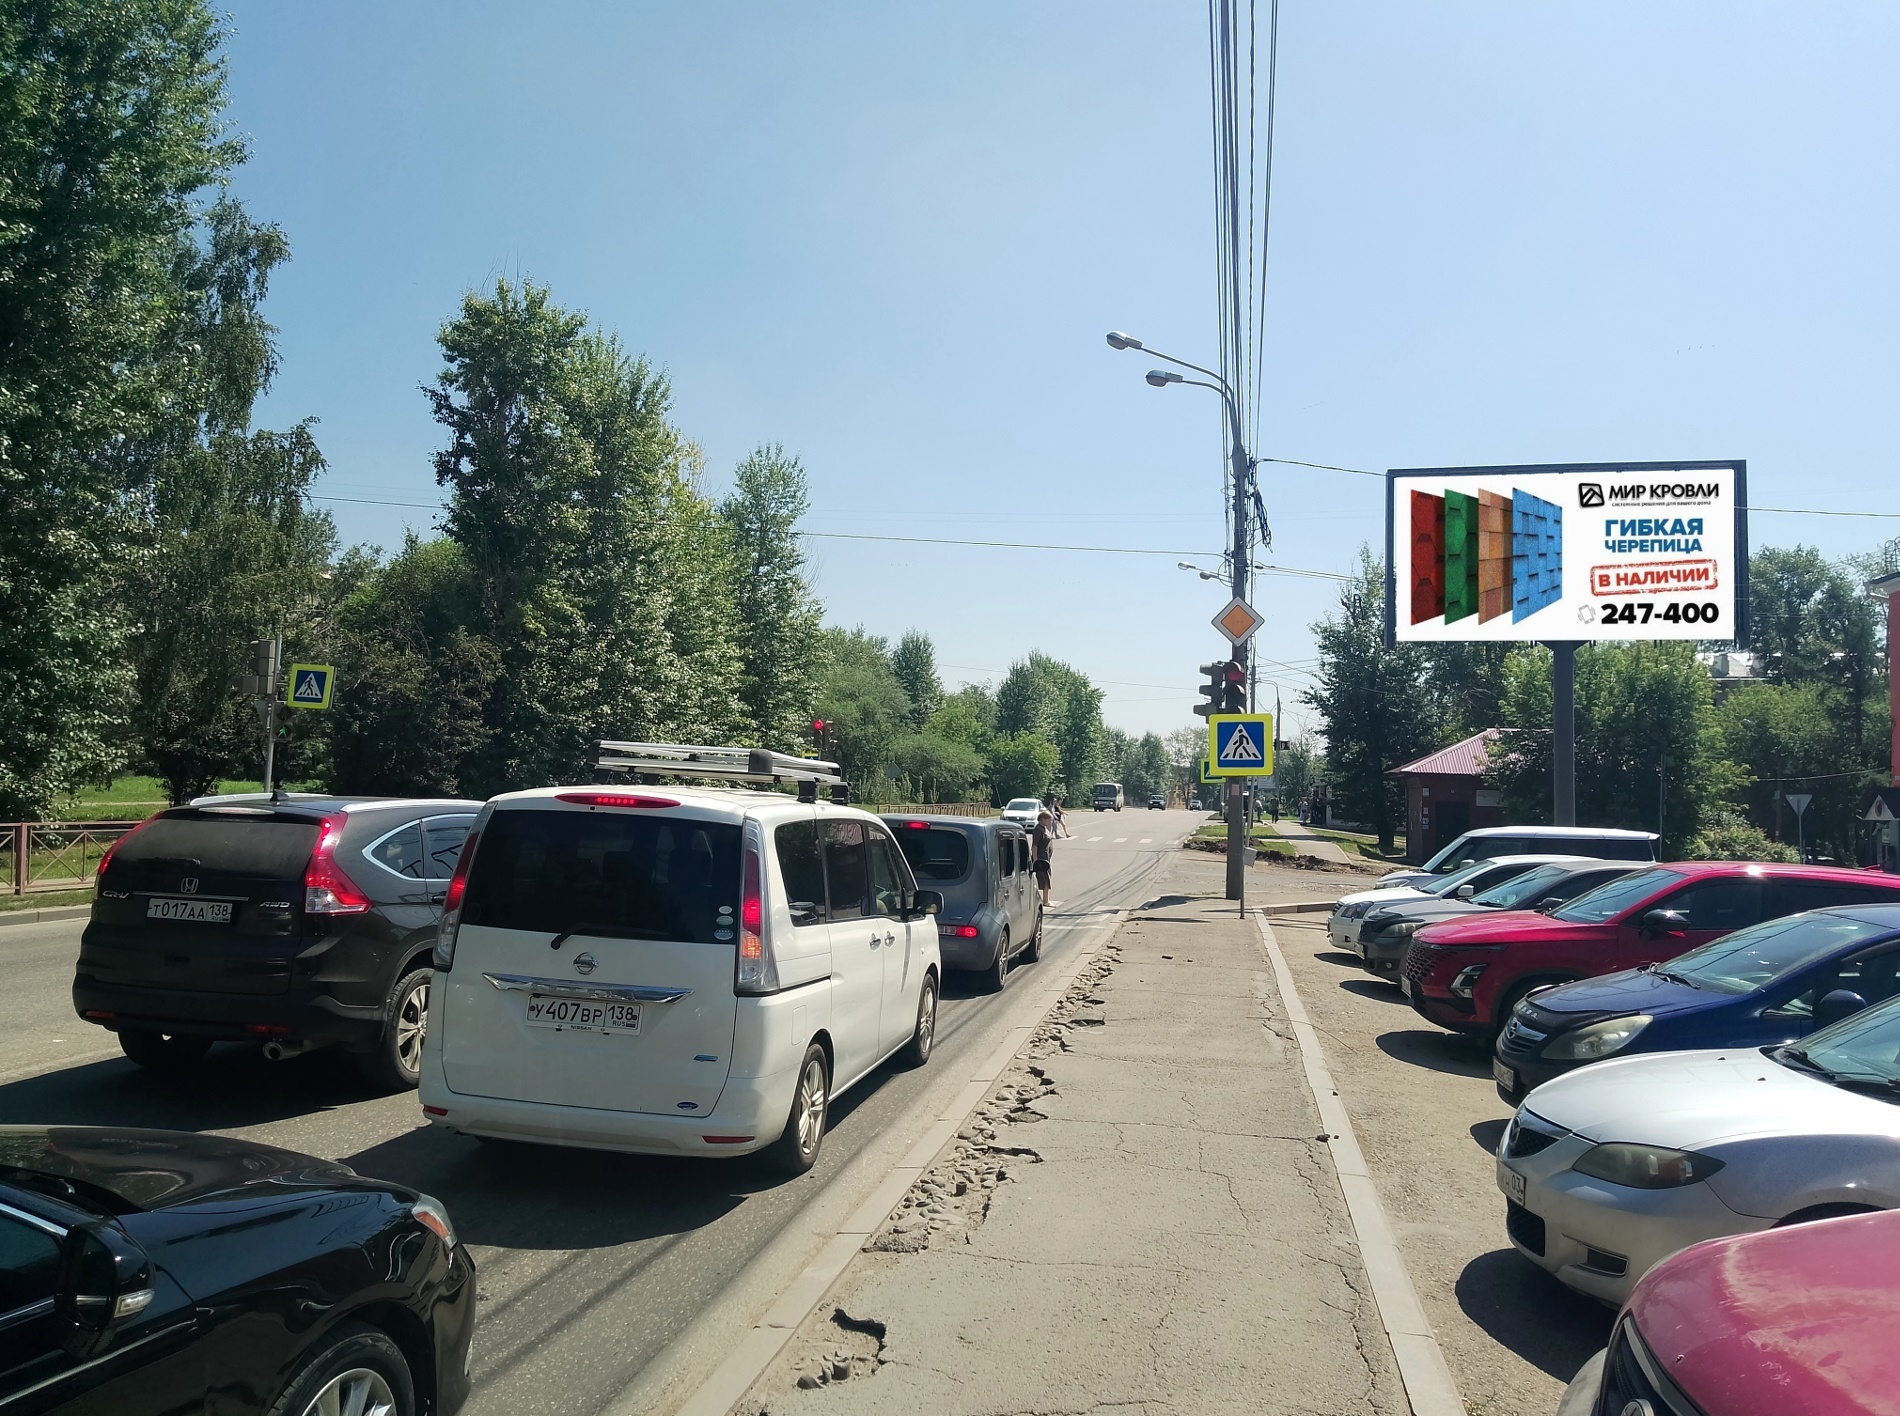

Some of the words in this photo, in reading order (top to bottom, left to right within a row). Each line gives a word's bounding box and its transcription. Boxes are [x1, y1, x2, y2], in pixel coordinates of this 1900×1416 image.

[1609, 485, 1646, 499] МИР
[1650, 483, 1720, 499] КРОВЛИ
[1605, 518, 1703, 536] ГИБКАЯ
[1604, 539, 1703, 554] ЧЕРЕПИЦА
[1598, 574, 1611, 587] В
[1615, 568, 1709, 586] НАЛИЧИИ
[1601, 602, 1719, 624] 247-400
[209, 904, 228, 916] 138
[608, 1005, 634, 1020] 138
